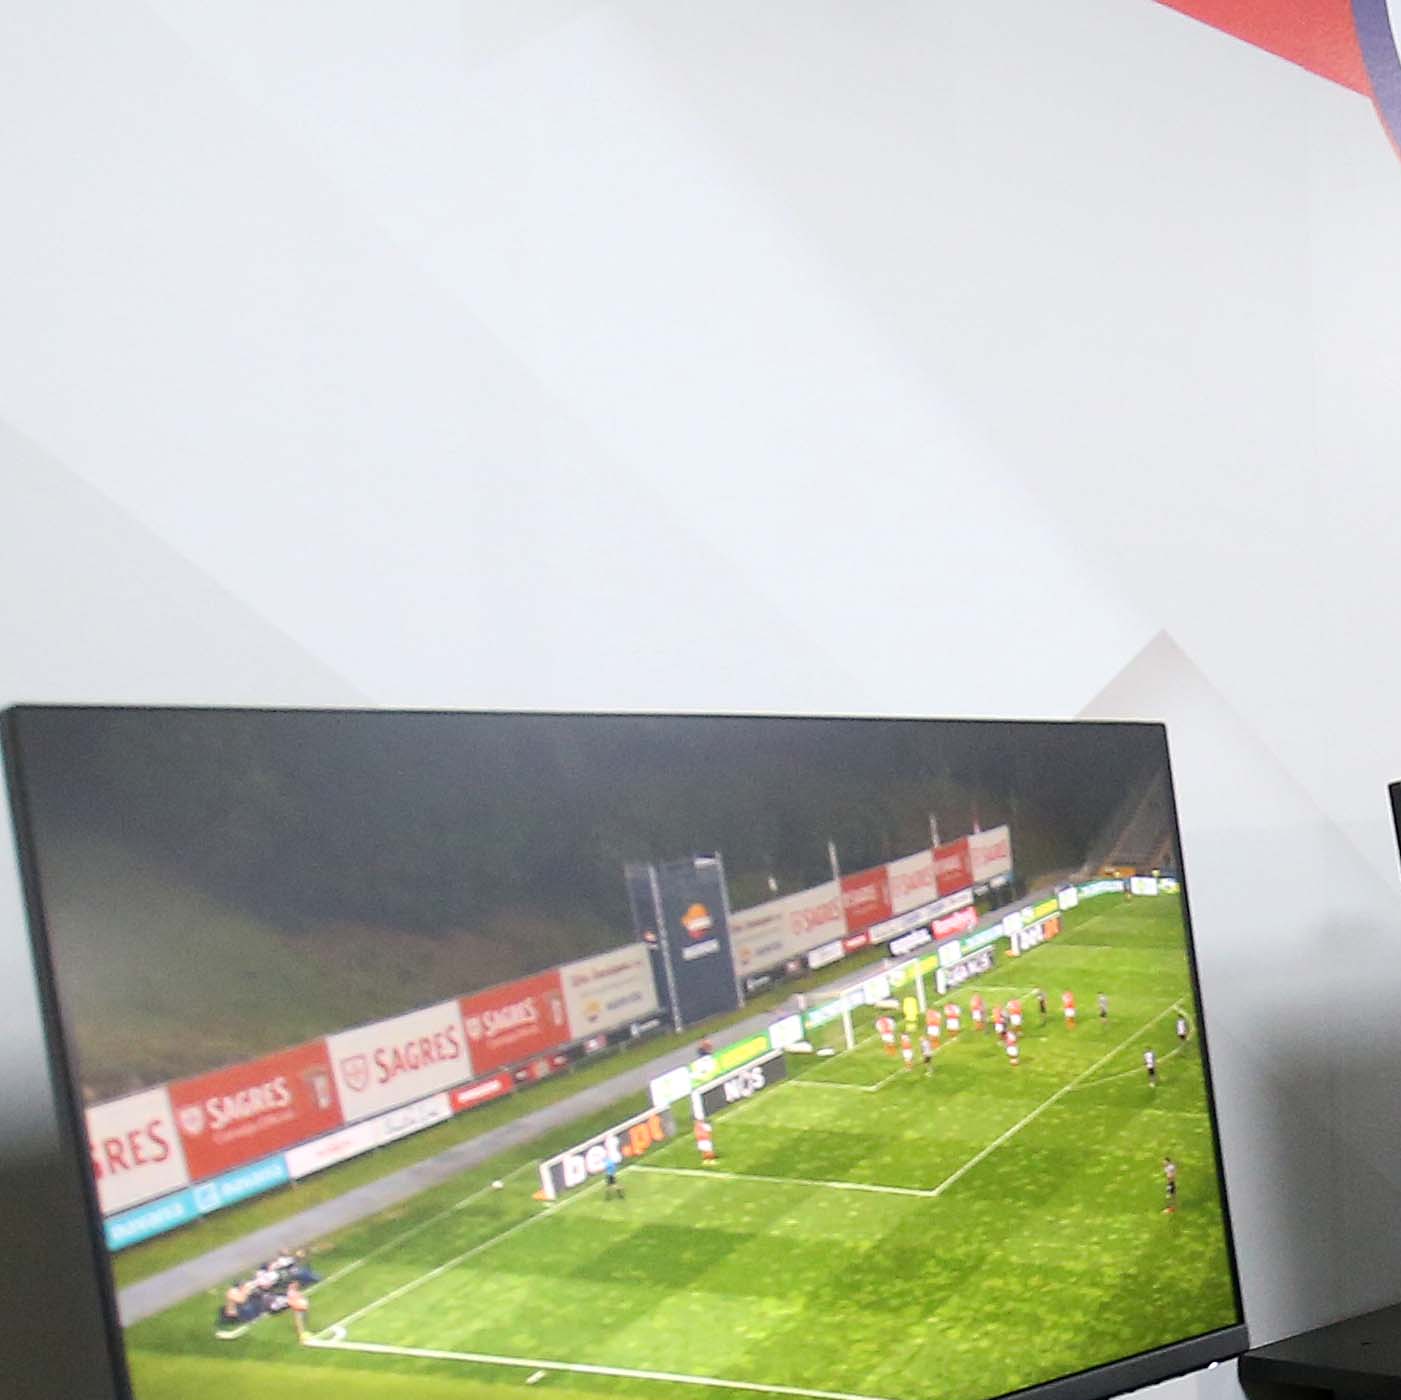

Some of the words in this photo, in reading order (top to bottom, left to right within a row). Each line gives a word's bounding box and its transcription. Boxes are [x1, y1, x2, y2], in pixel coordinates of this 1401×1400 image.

[374, 1024, 460, 1084] SAGRES
[205, 1076, 291, 1131] SAGRES
[562, 1113, 666, 1188] bet.pt
